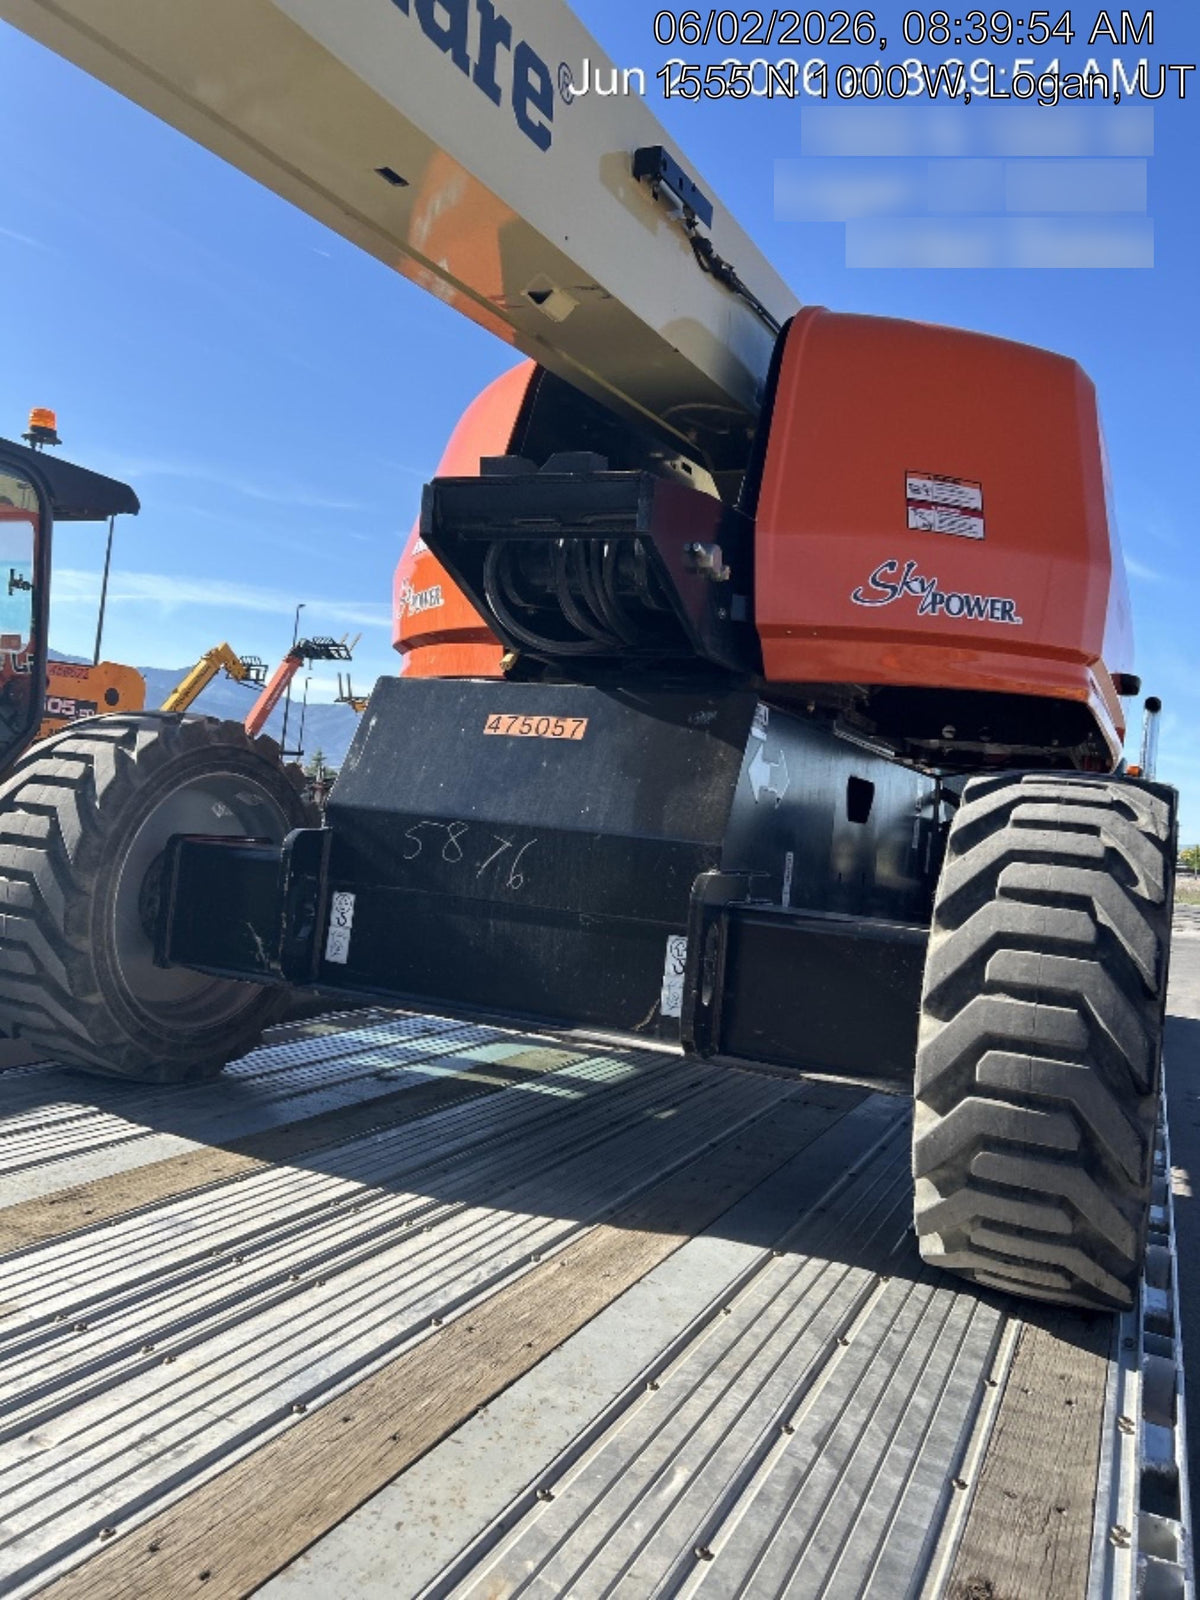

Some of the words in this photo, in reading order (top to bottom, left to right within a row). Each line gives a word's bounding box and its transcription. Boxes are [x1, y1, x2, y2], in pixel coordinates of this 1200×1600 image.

[391, 0, 555, 153] are
[487, 714, 585, 739] 475057
[401, 820, 538, 891] 5876
